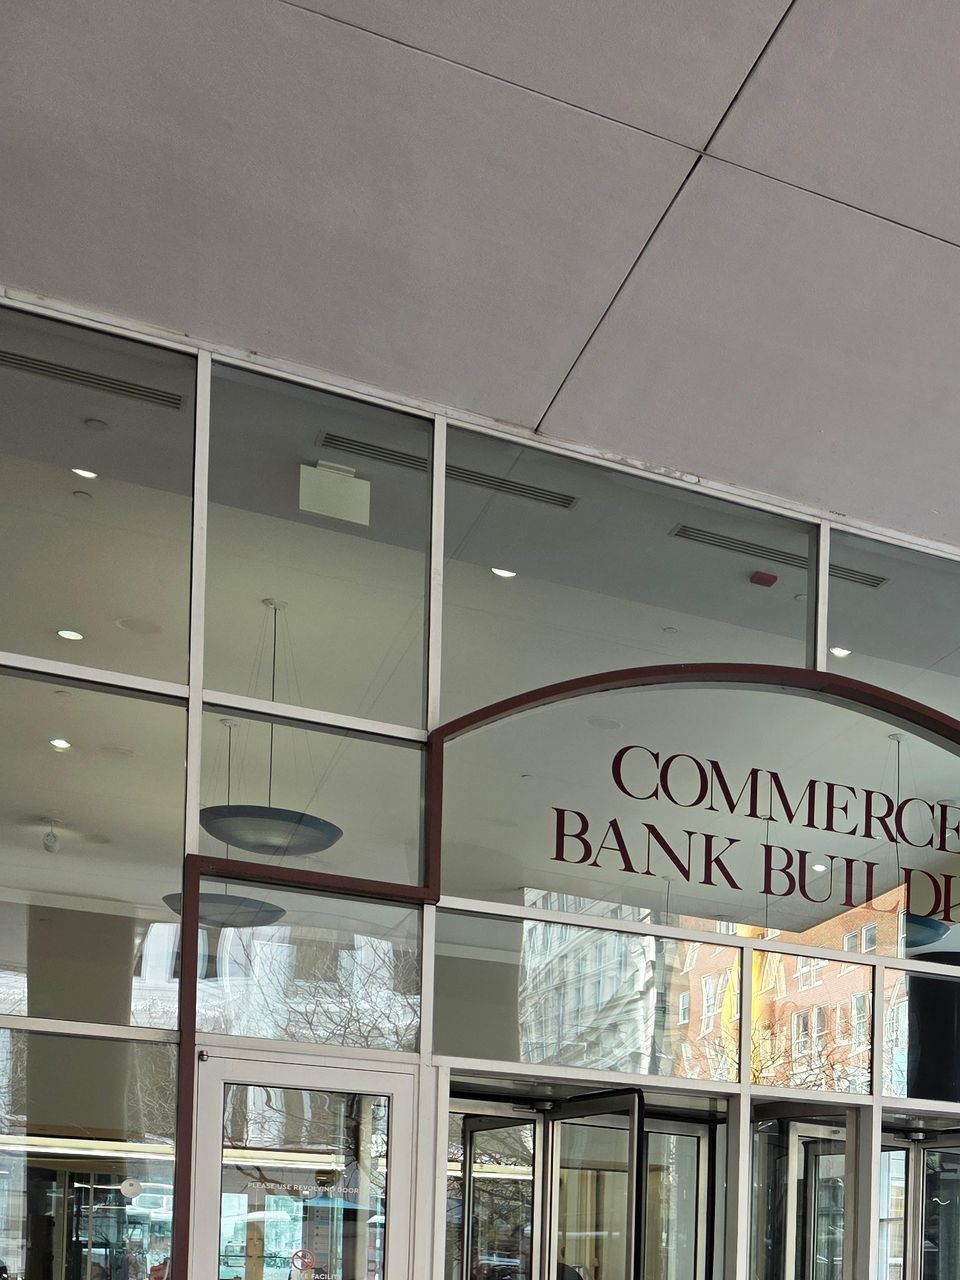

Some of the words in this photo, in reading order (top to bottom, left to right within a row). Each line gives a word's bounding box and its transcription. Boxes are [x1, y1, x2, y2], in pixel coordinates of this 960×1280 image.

[550, 807, 742, 891] BANK
[247, 1182, 276, 1190] PLEASE
[293, 1185, 336, 1193] REVOLVING
